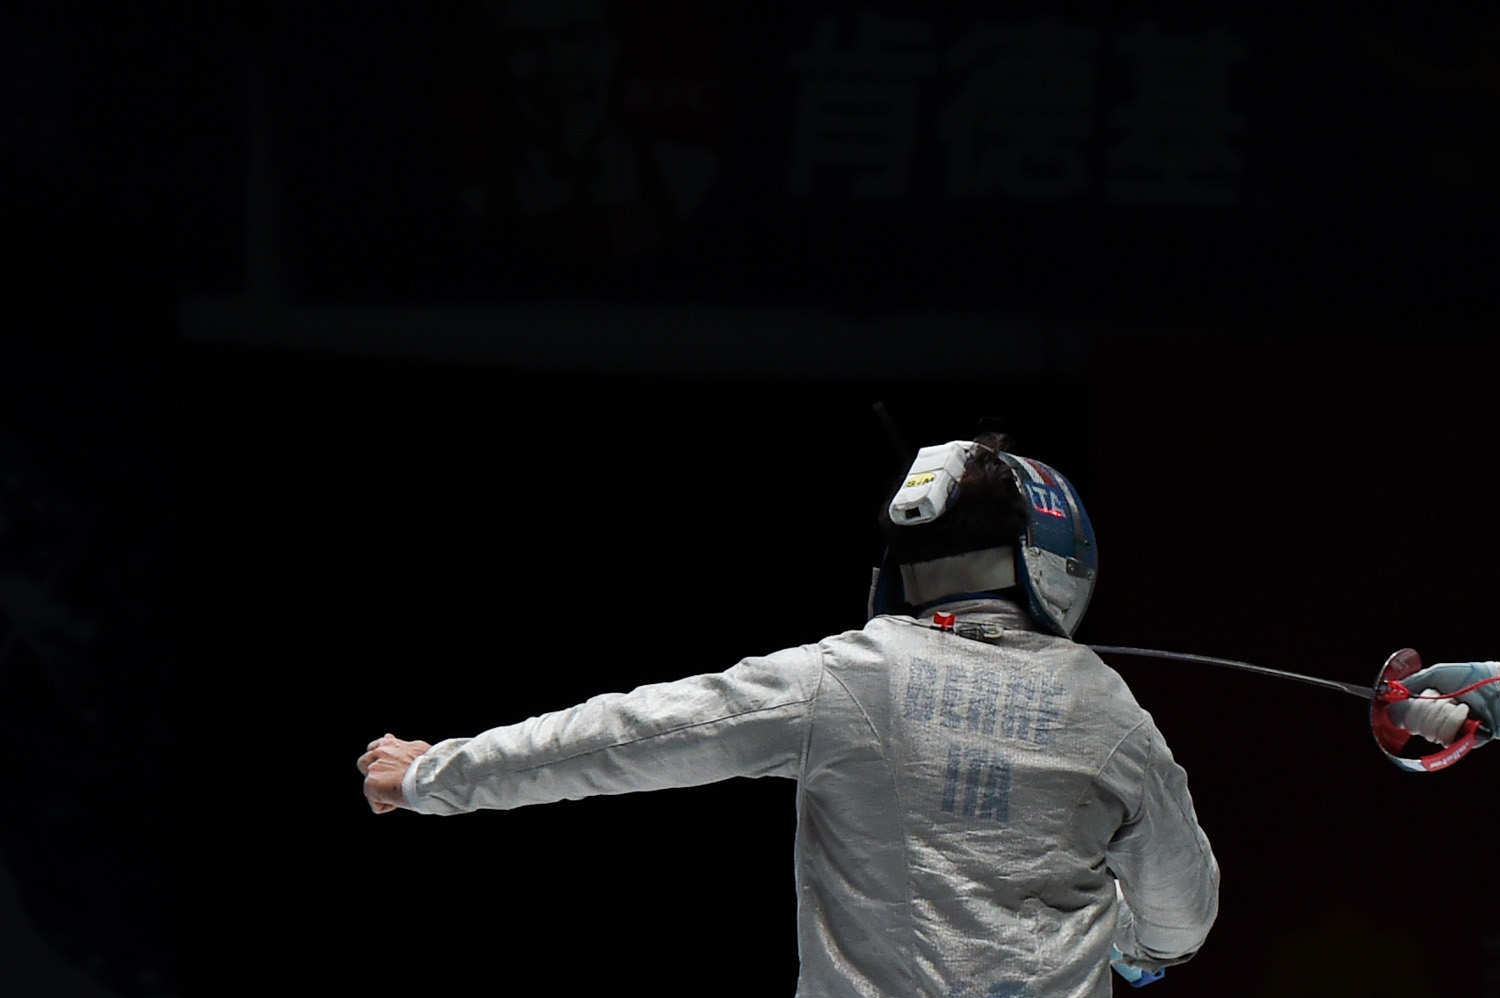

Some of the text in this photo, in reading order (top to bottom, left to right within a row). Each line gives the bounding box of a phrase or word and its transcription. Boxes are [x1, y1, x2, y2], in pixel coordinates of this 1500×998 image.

[785, 9, 1248, 206] 肯德基
[942, 743, 1012, 823] ITA
